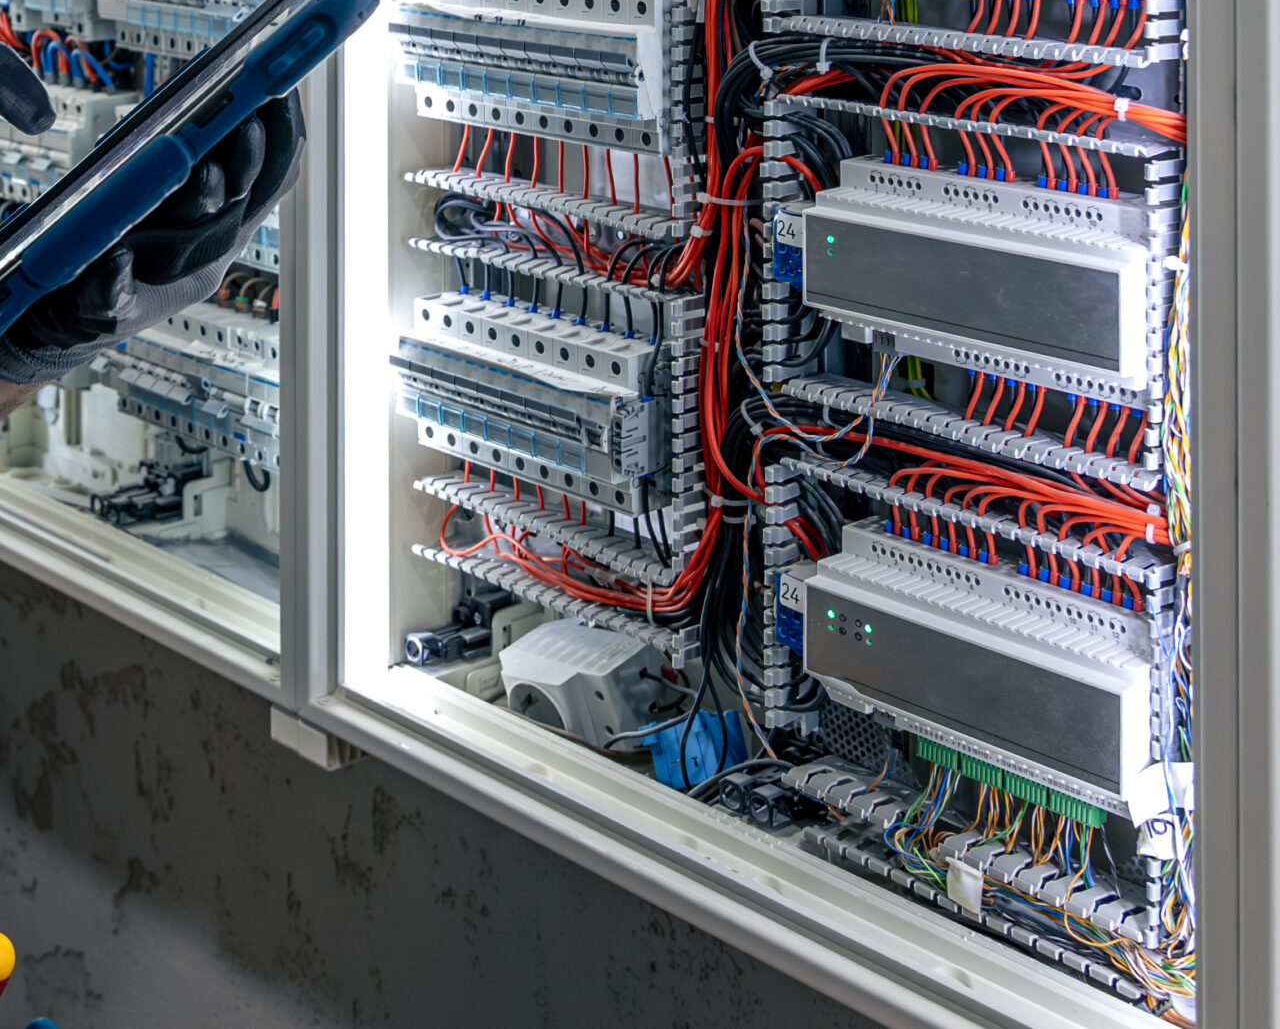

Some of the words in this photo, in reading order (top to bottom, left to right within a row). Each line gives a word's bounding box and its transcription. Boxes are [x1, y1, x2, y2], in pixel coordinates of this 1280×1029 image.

[778, 219, 797, 240] 24
[781, 582, 800, 605] 24
[1069, 617, 1077, 625] 10
[1091, 624, 1098, 632] 11
[1112, 631, 1120, 639] 12
